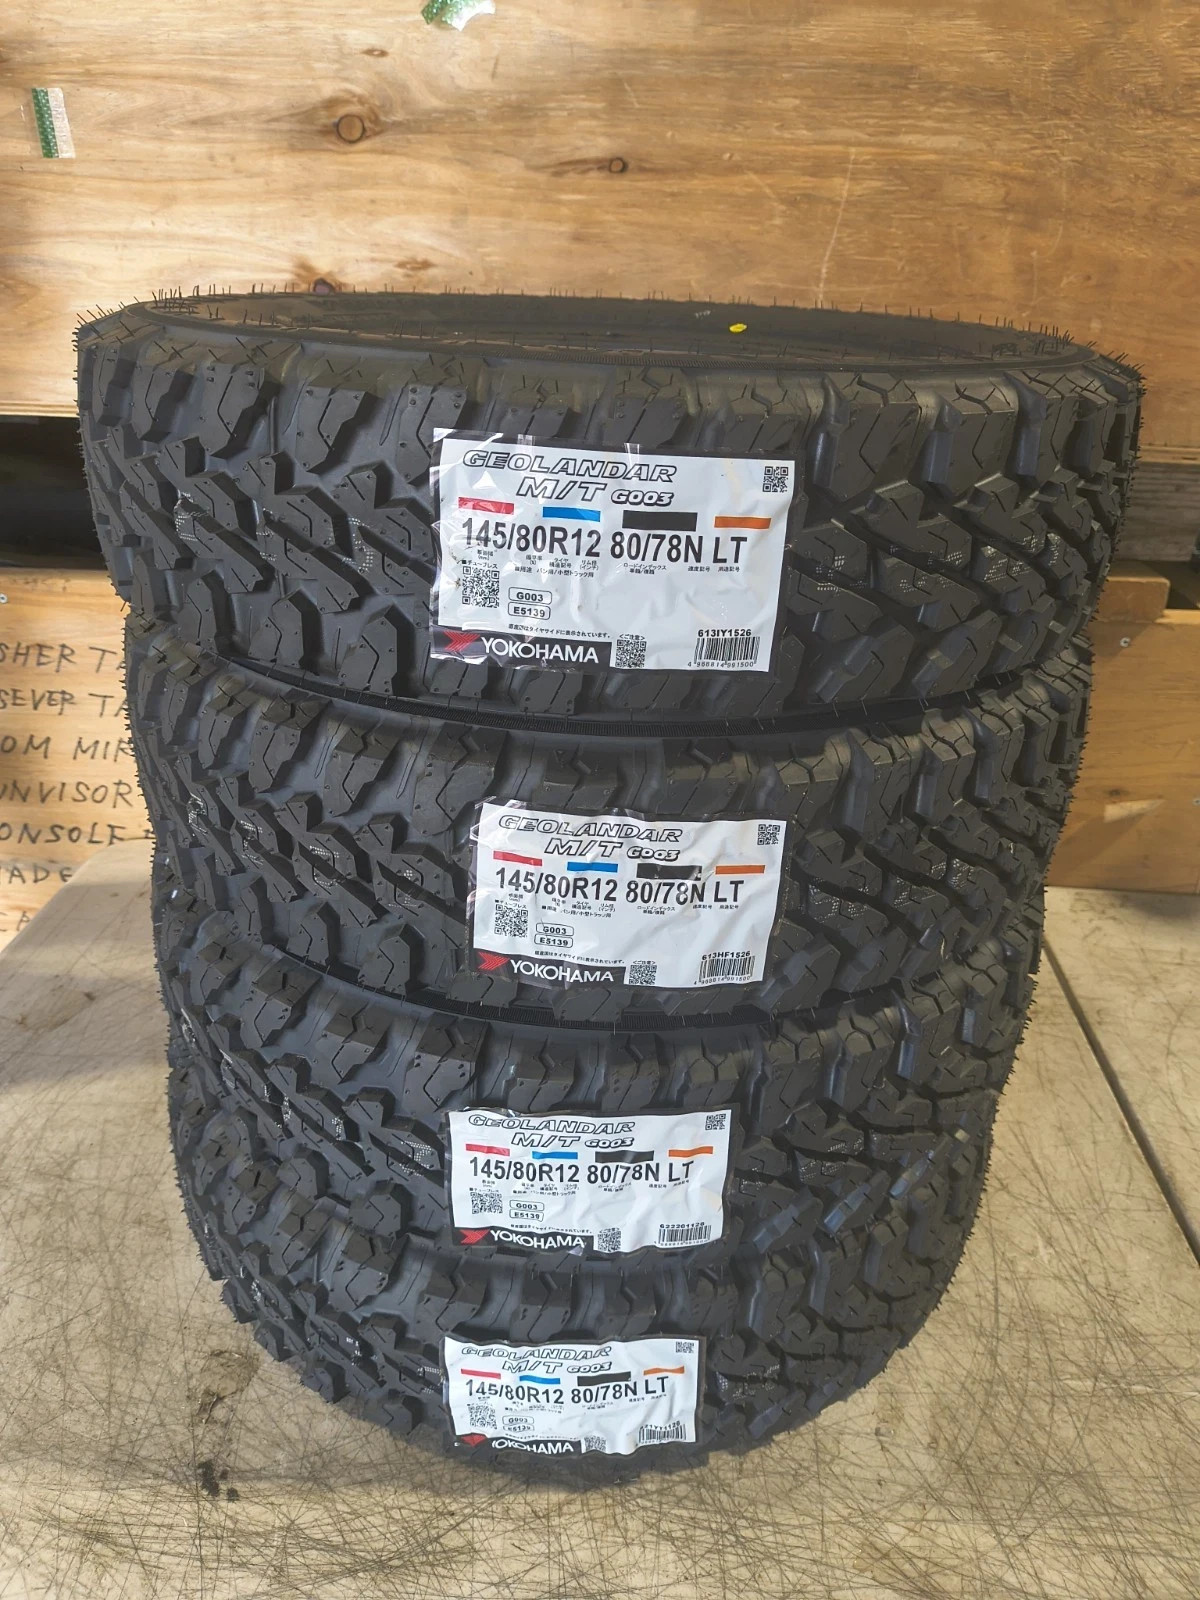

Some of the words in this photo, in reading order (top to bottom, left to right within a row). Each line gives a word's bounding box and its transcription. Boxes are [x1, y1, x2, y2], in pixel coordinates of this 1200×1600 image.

[463, 450, 677, 483] GEOLANDAR
[516, 476, 607, 502] M/T
[611, 489, 675, 507] G003
[462, 518, 601, 557] 145/80R12
[610, 531, 703, 564] 80/78N
[712, 536, 748, 564] LT
[516, 591, 544, 602] G003
[513, 606, 546, 618] E5139
[481, 636, 600, 664] YOKOHAMA
[498, 815, 683, 843] GEOLANDAR
[544, 837, 623, 858] M/T
[627, 845, 680, 861] G003
[495, 867, 618, 902] 145/80R12
[626, 880, 706, 905] 80/78N
[714, 880, 744, 903] LT
[539, 937, 569, 947] E5139
[542, 926, 567, 935] G003
[510, 959, 614, 983] YOKOHAMA
[468, 1114, 635, 1134] GEOLANDAR
[511, 1132, 581, 1148] M/T
[469, 1156, 580, 1183] 145/80R12
[587, 1163, 660, 1184] 80/78N
[668, 1160, 694, 1182] LT
[490, 1230, 585, 1250] YOKOHAMA
[461, 1346, 612, 1361] GEOLANDAR
[502, 1359, 563, 1374] M/T
[465, 1379, 564, 1405] 145/80R12
[571, 1381, 638, 1404] 80/78N
[645, 1376, 669, 1395] LT
